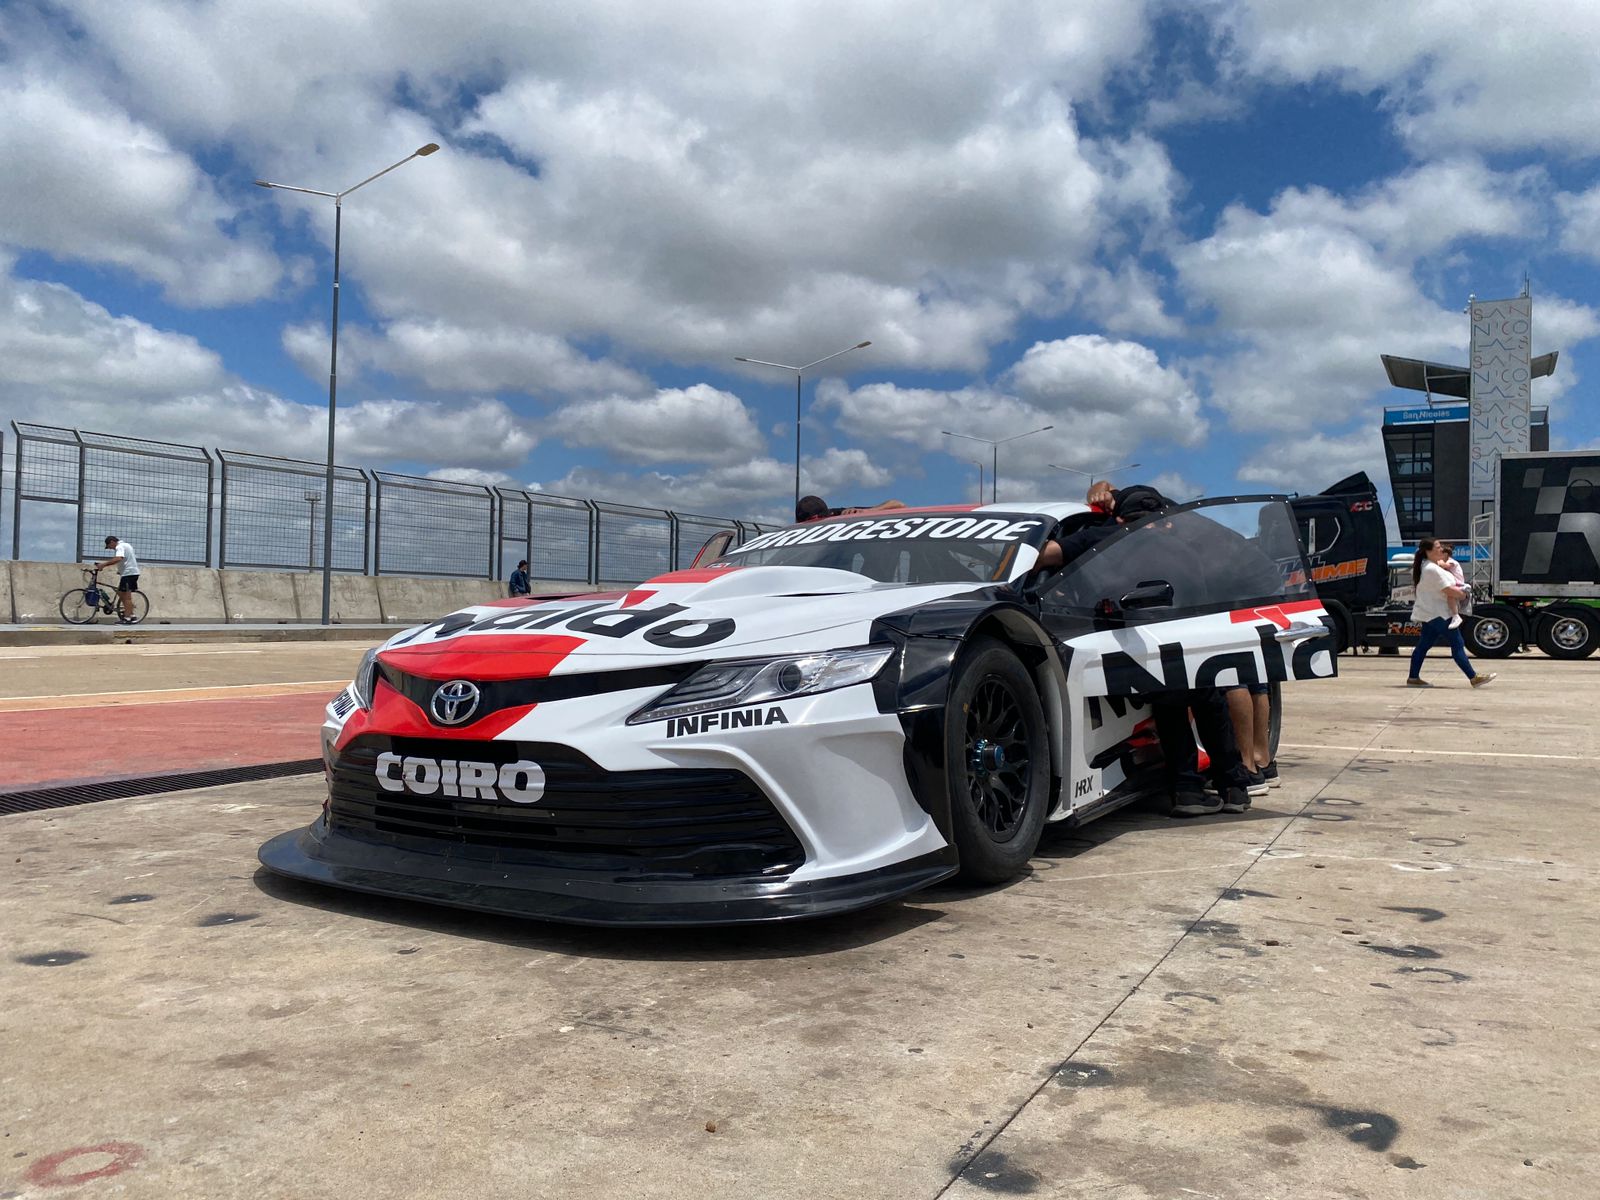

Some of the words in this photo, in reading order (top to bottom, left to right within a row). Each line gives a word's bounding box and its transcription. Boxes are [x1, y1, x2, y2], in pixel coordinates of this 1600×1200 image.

[1402, 411, 1418, 420] San
[1419, 410, 1450, 419] Nicolás
[726, 517, 1041, 555] BRIDGESTONE
[391, 602, 736, 648] Naldo
[667, 706, 789, 738] INFINIA
[375, 751, 546, 803] COIRO
[1075, 775, 1093, 798] HRX
